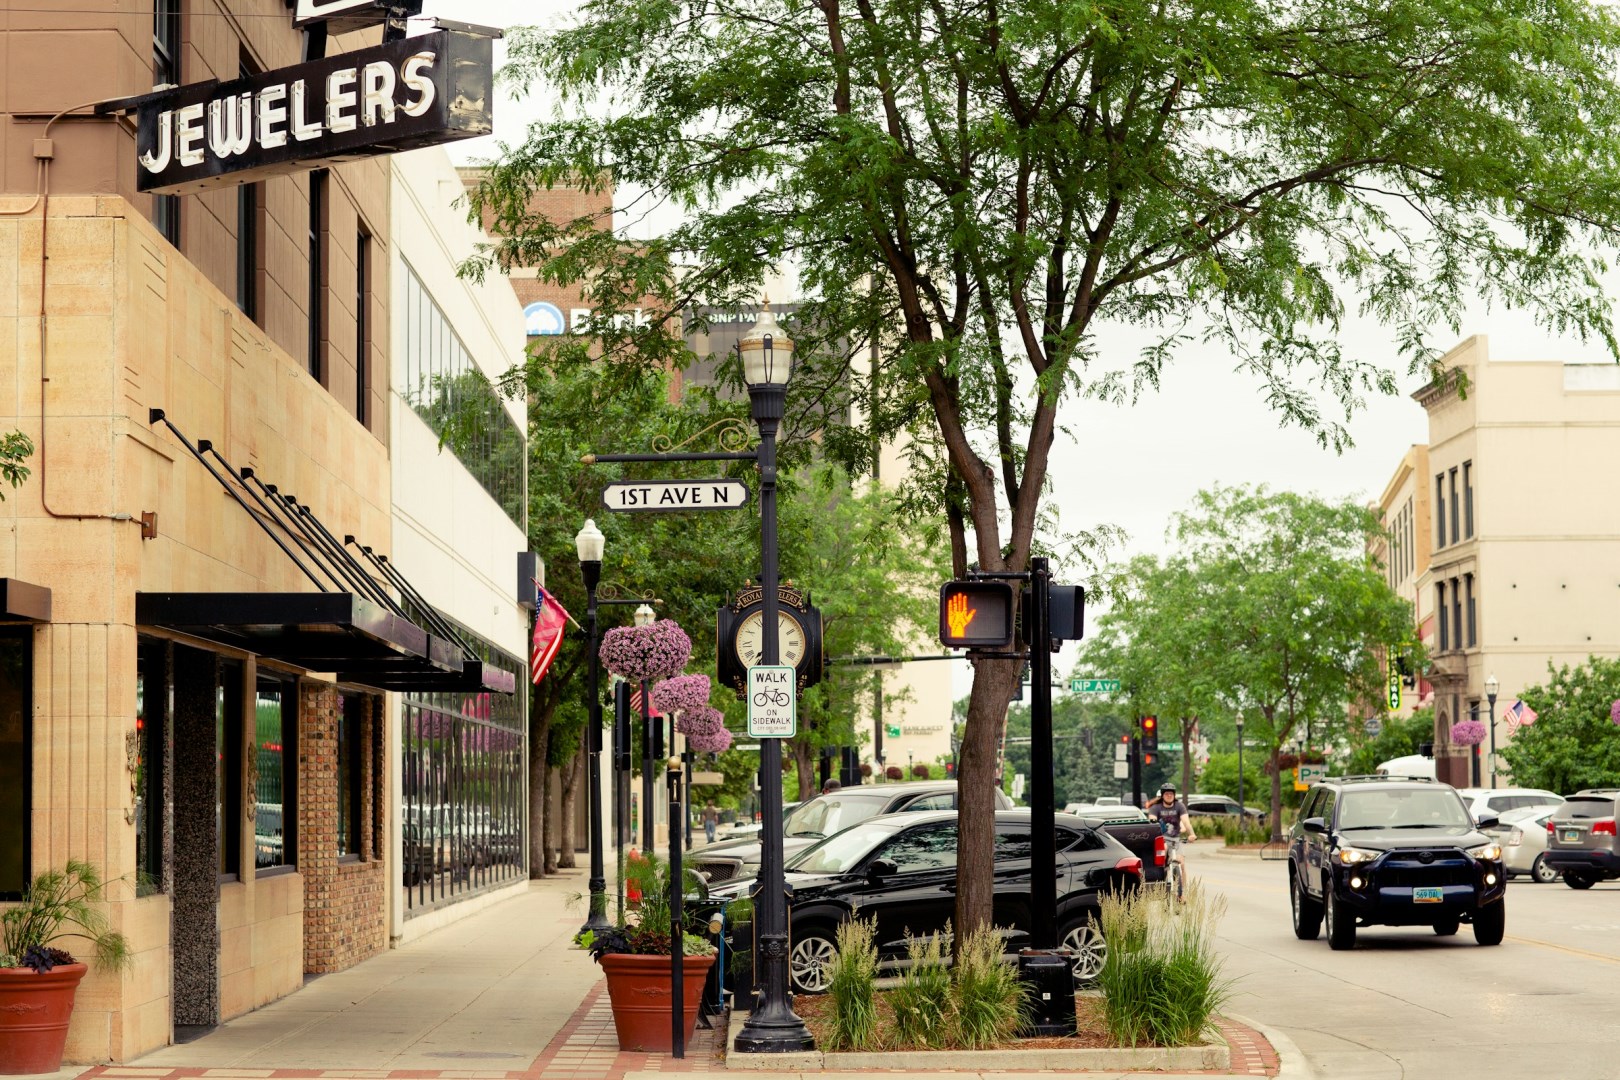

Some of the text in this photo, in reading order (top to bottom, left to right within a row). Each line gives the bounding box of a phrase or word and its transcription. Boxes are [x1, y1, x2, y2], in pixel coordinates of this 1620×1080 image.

[138, 51, 436, 174] JEWELERS
[709, 312, 796, 324] BNP PABAS
[620, 486, 728, 505] 1ST AVE N
[755, 673, 787, 683] WALK
[1074, 681, 1118, 691] NP Ave
[752, 717, 791, 725] SIDEWALK
[1301, 768, 1311, 781] P
